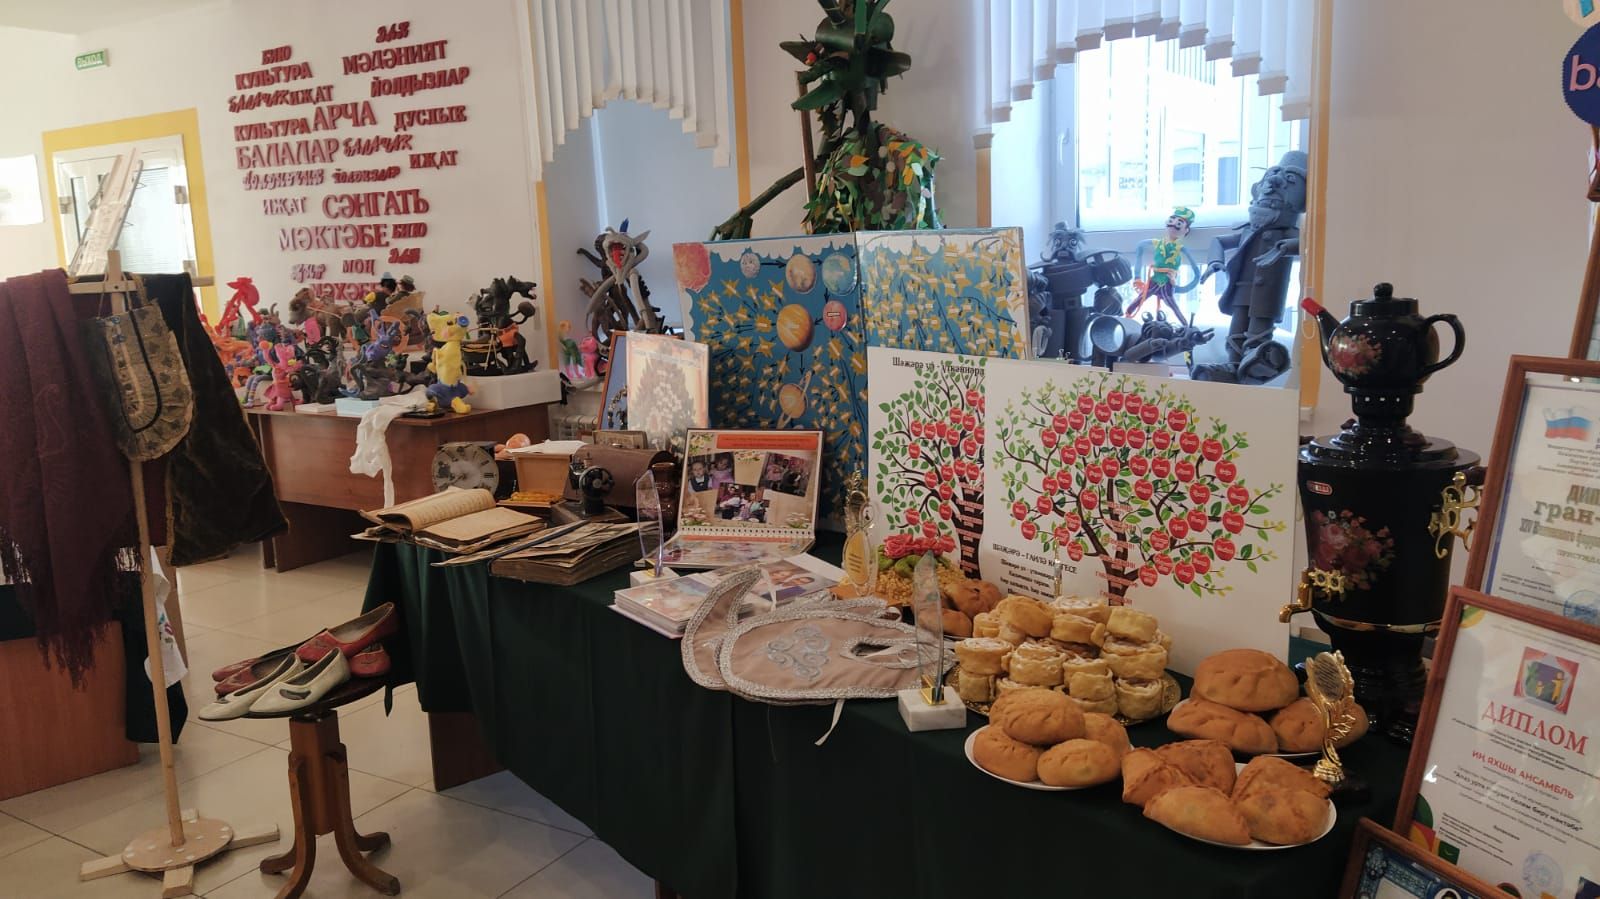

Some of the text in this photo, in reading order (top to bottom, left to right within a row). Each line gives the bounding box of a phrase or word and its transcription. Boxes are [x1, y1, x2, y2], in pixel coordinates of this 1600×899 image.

[342, 40, 448, 76] МӘДӘНИЯТ
[235, 62, 314, 90] КУЛЬТУРА
[370, 67, 470, 97] ЙОЛДЫЗЛАР
[234, 118, 312, 141] КУЛЬТУРА
[312, 101, 377, 131] АРЧА
[394, 105, 468, 132] ДУСЛЫК
[235, 138, 340, 169] БАЛАЛАР
[409, 150, 458, 170] ИҖАТ
[322, 189, 431, 219] СӘНГАТЬ
[279, 223, 390, 251] МӘКТӘБЕ
[342, 258, 376, 276] МОҢ
[1481, 701, 1589, 756] ДИПЛОМ
[1487, 756, 1517, 774] ЯХШЫ
[1518, 770, 1574, 799] АНСАМБЛЬ
